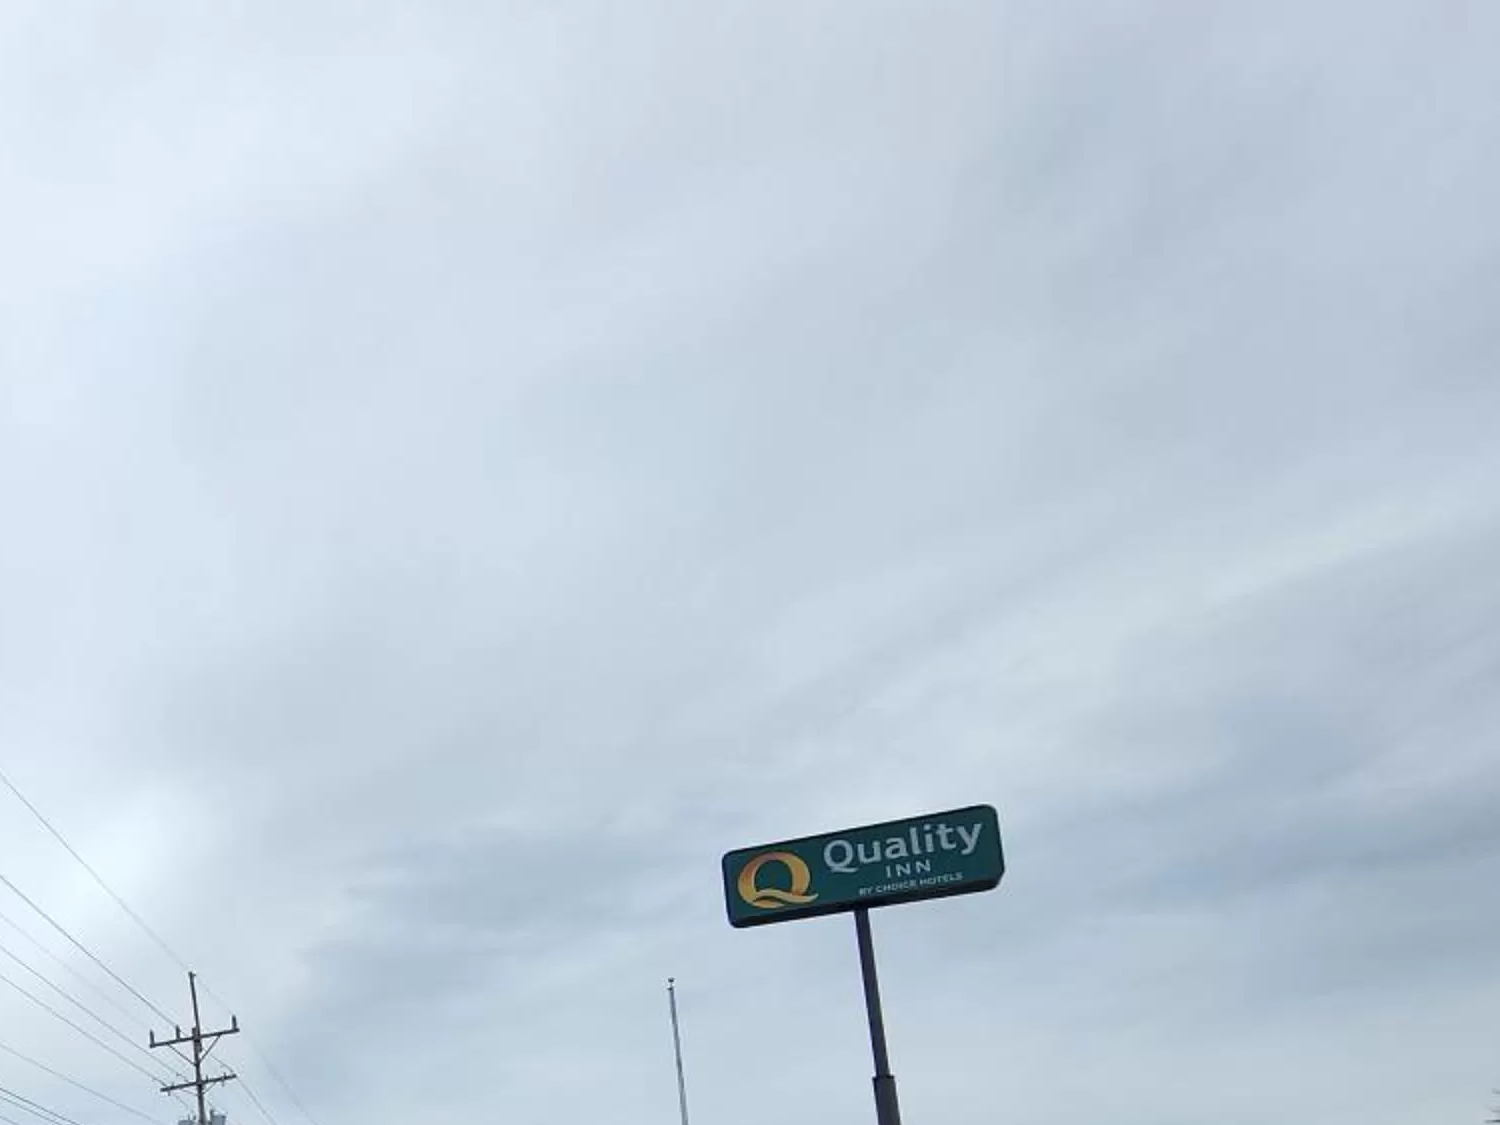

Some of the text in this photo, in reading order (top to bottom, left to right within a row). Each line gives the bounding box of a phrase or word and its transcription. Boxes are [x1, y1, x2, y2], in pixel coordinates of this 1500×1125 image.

[823, 821, 982, 873] Quality
[737, 850, 819, 909] Q
[875, 879, 918, 894] CHOICE
[919, 872, 964, 886] HOTELS
[885, 859, 932, 878] INN
